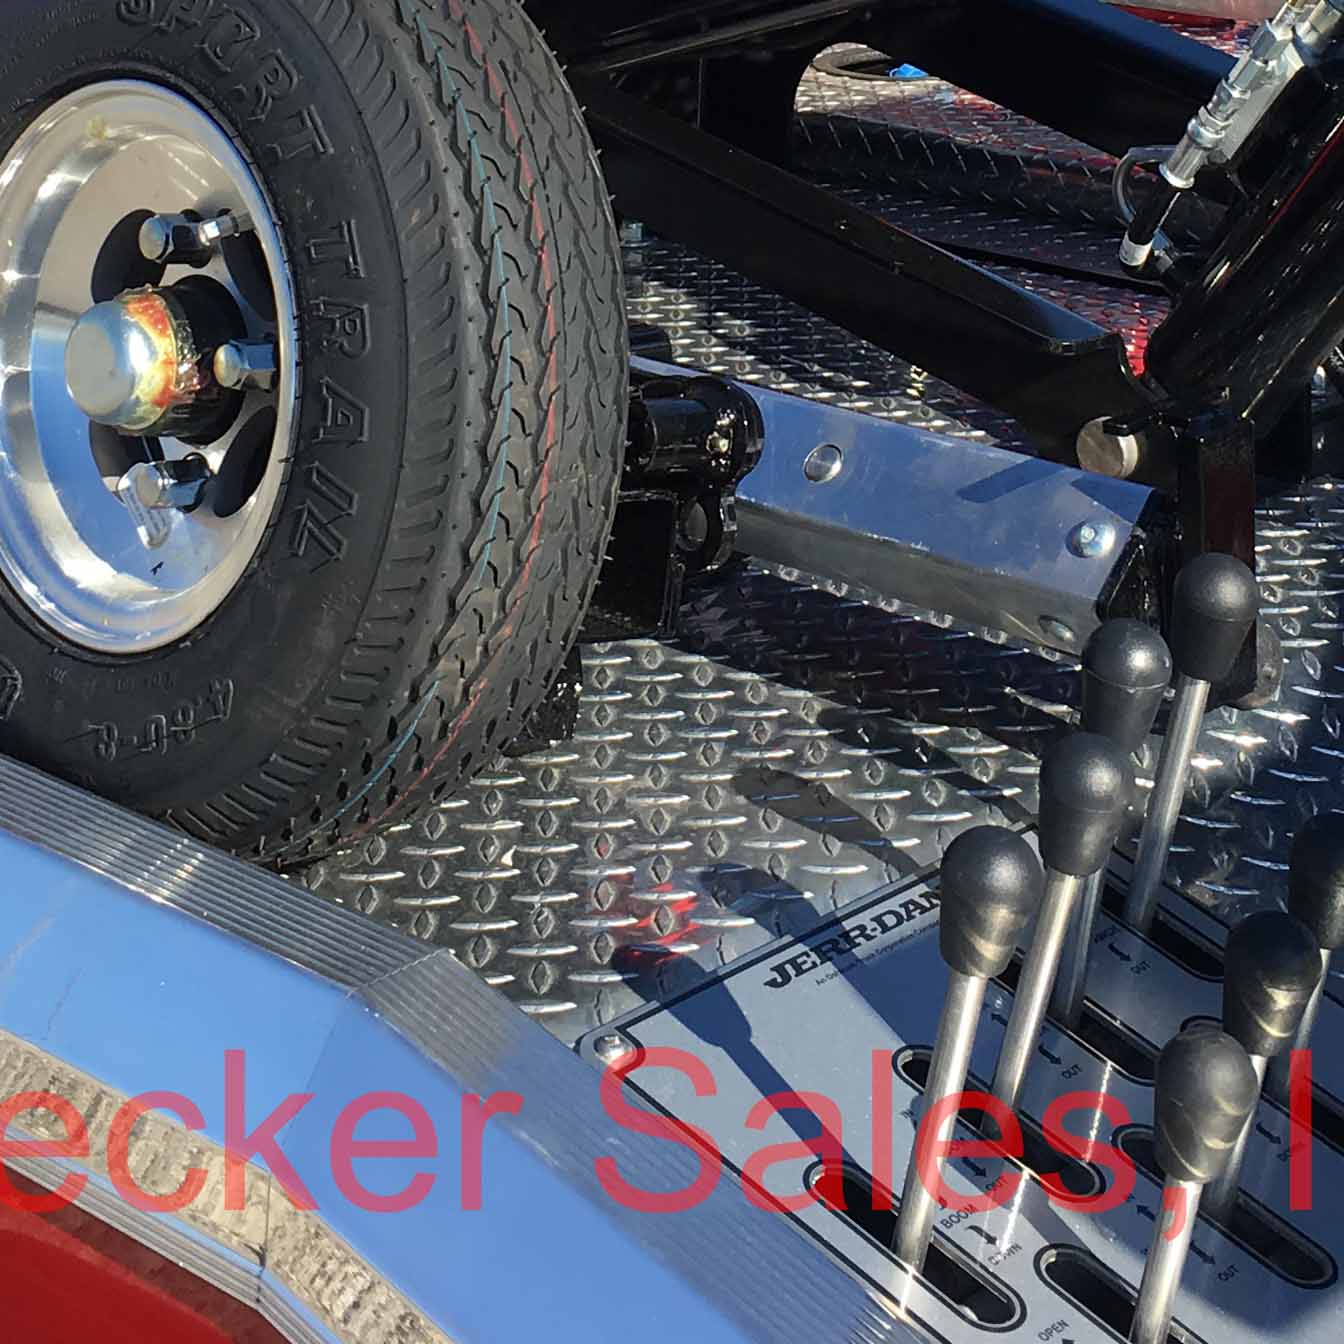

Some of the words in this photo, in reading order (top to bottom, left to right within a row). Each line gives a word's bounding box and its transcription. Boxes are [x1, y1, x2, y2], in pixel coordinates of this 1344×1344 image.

[288, 219, 371, 563] TRAIL
[1061, 1064, 1083, 1080] OUT
[940, 1203, 977, 1230] BOOM
[1217, 1265, 1240, 1282] OUT
[1038, 1319, 1070, 1342] OPEN
